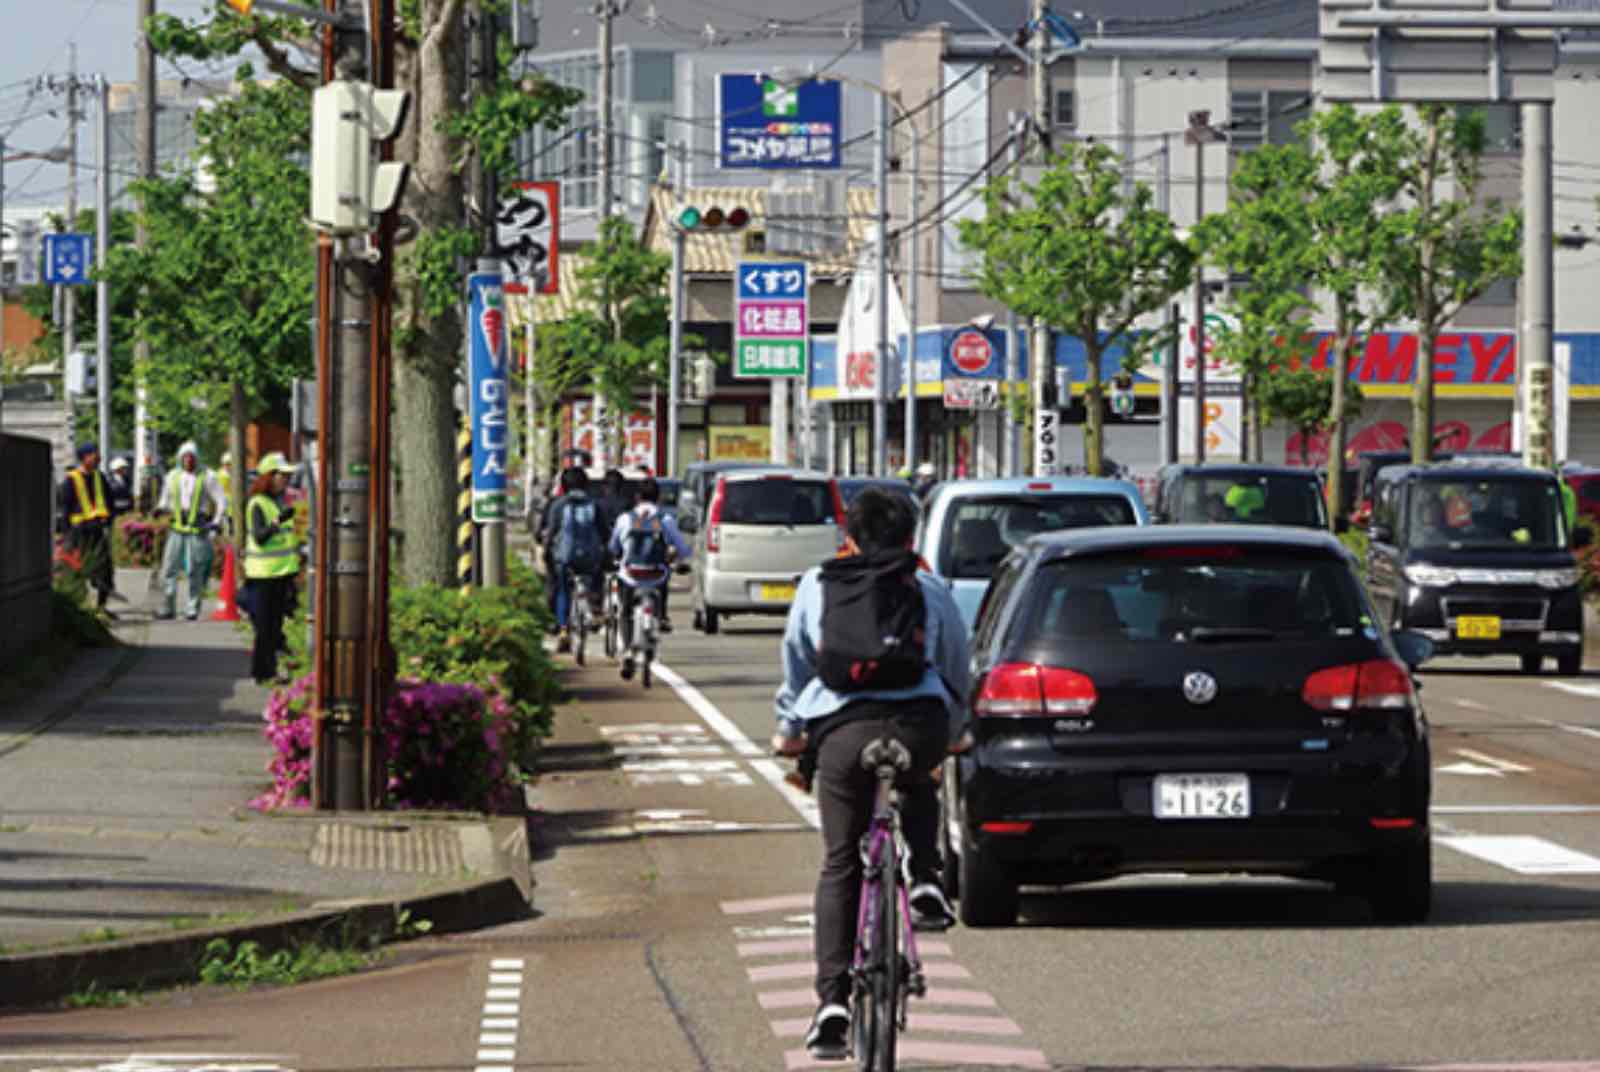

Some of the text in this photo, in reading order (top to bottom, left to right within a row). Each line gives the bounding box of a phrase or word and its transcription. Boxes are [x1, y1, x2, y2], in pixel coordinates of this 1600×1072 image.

[744, 269, 802, 293] くすり
[744, 306, 802, 333] 化粧品
